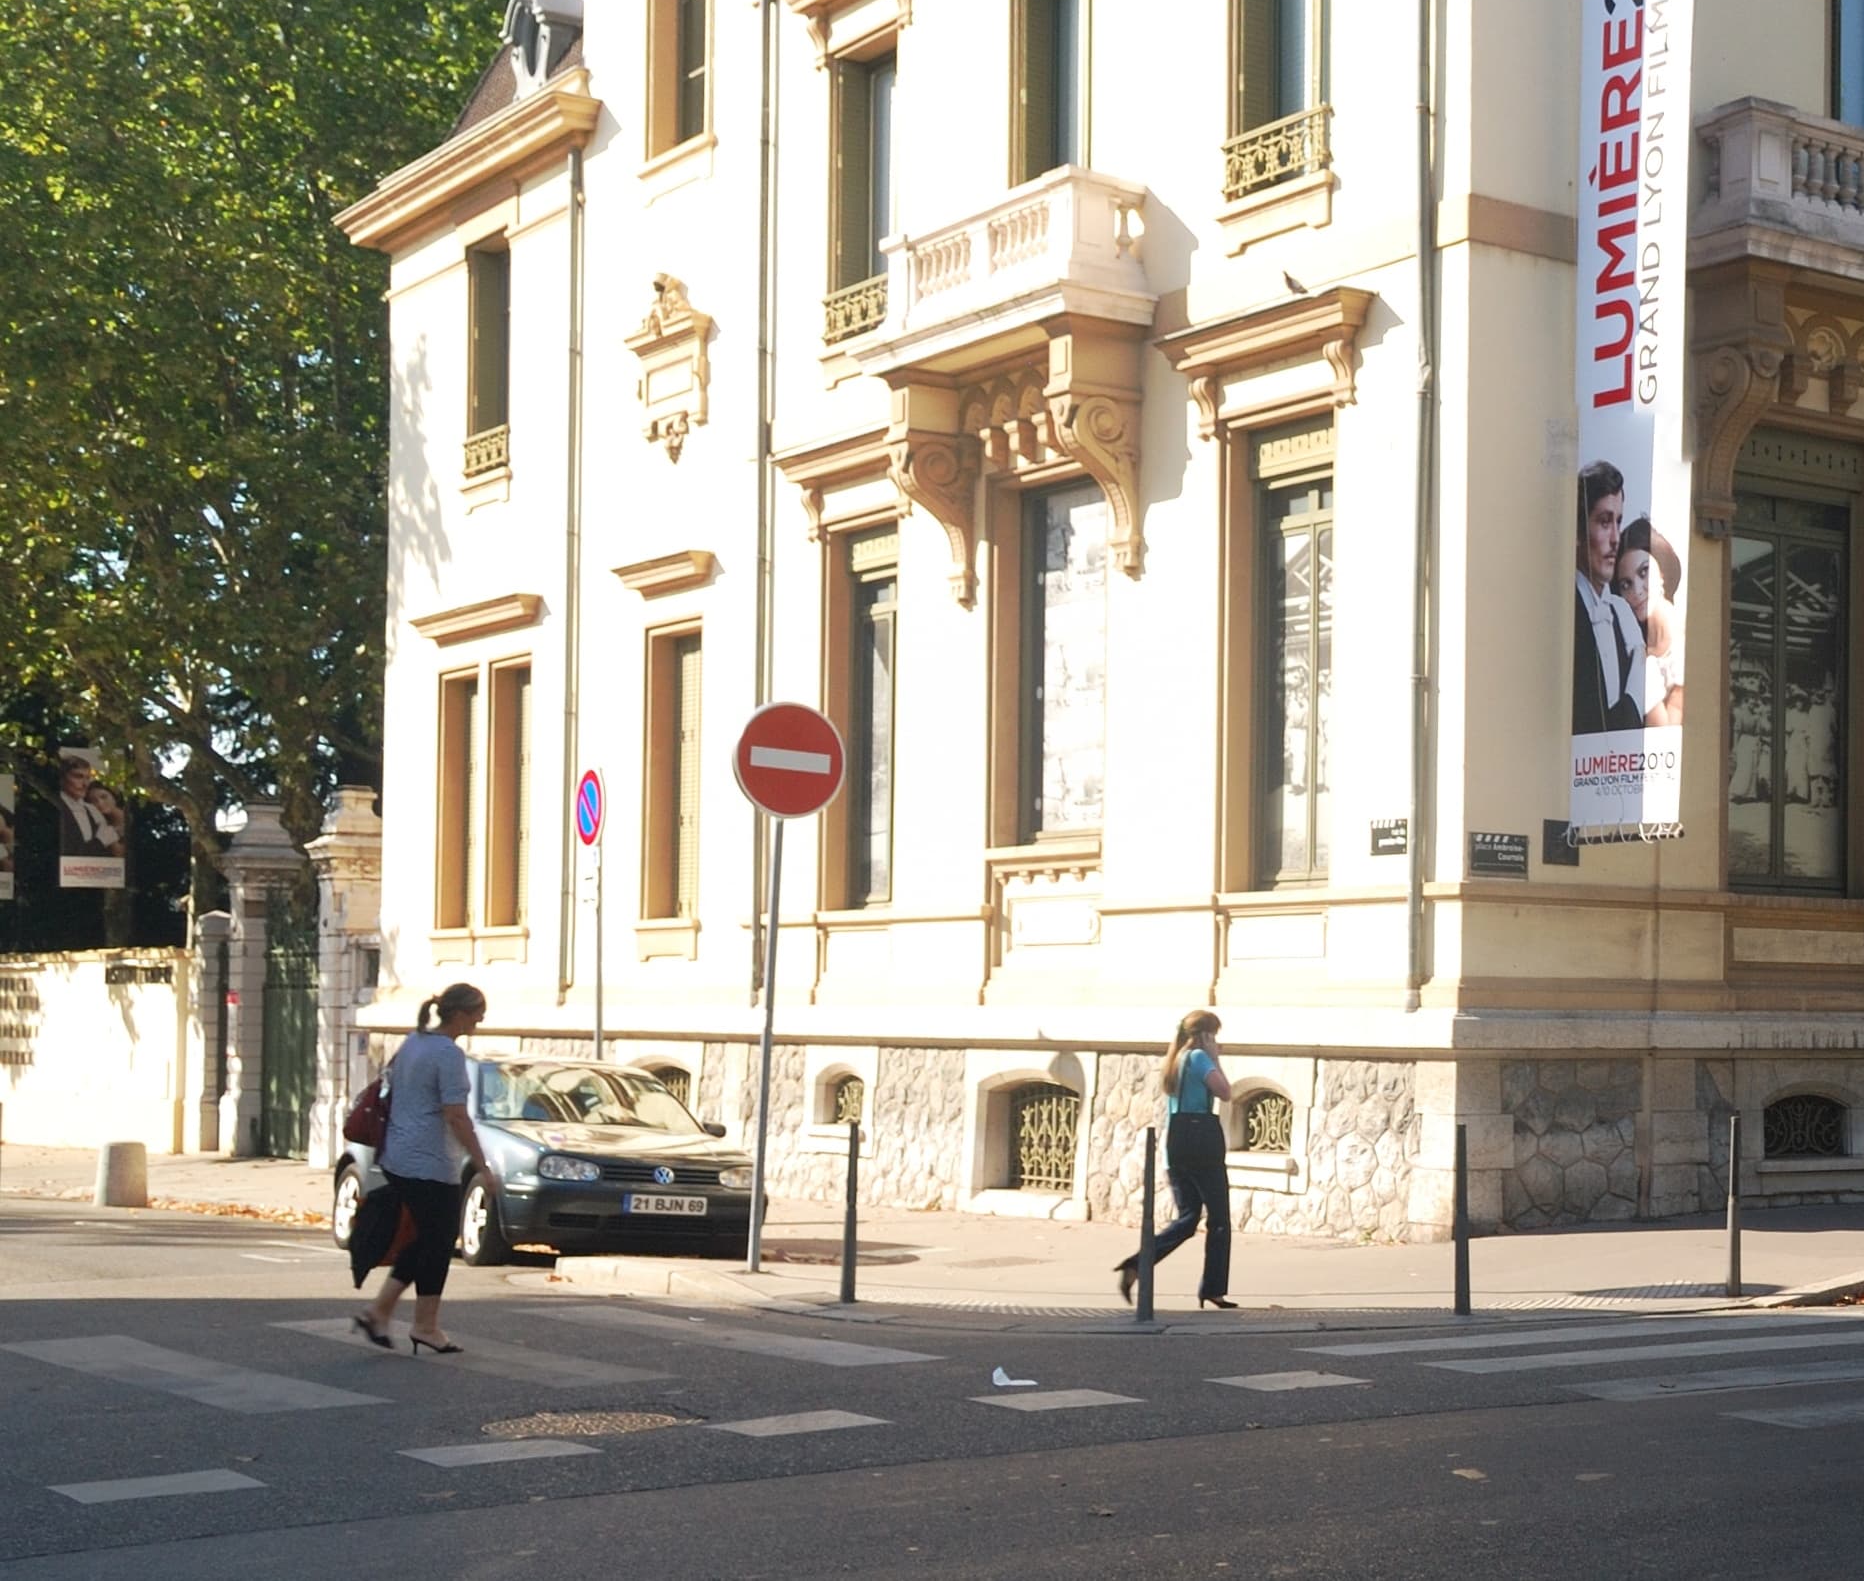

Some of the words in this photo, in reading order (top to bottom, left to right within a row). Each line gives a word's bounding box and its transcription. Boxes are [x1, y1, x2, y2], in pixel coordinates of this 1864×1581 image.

[1643, 112, 1665, 227] LYON
[1638, 242, 1660, 405] GRAND
[1573, 777, 1600, 788] GRAND
[1601, 775, 1619, 785] LYON
[1620, 773, 1639, 784] FILM
[633, 1197, 649, 1210] 21
[655, 1198, 684, 1211] BJN
[688, 1199, 705, 1212] 69
